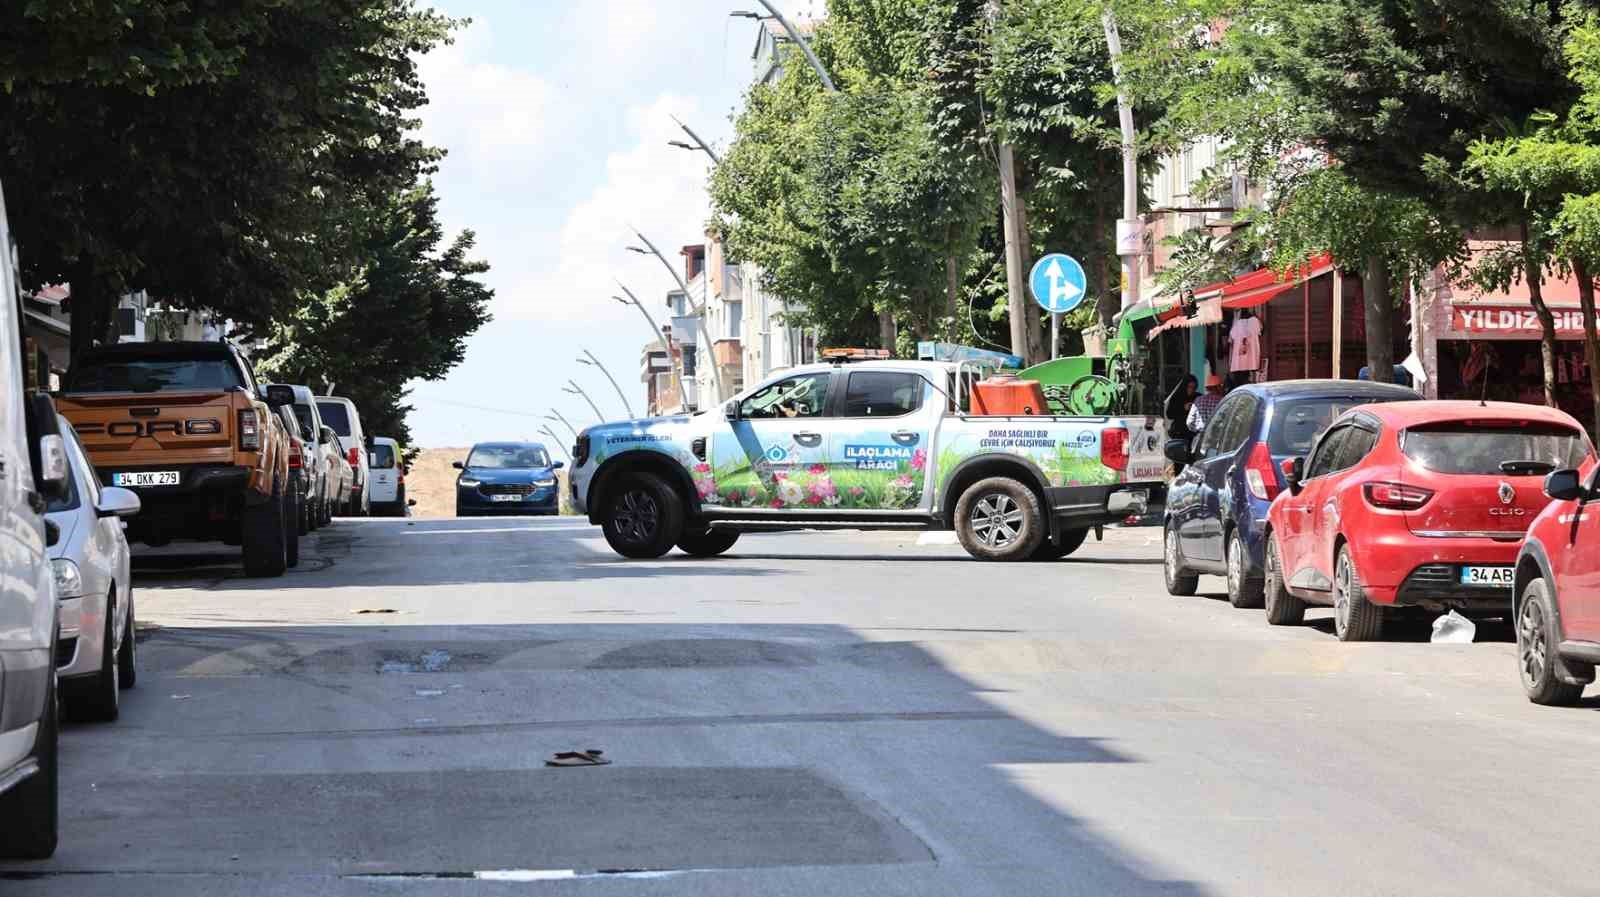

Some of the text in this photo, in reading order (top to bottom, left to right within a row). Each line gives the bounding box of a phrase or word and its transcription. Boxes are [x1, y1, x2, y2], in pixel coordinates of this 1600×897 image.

[1461, 310, 1600, 330] YILDIZ GID
[847, 447, 911, 459] İLAÇLAMA
[858, 460, 897, 470] ARACI
[120, 473, 177, 485] 34 DKK 279
[1488, 507, 1525, 515] CLIO
[1470, 568, 1513, 582] 34 AB
